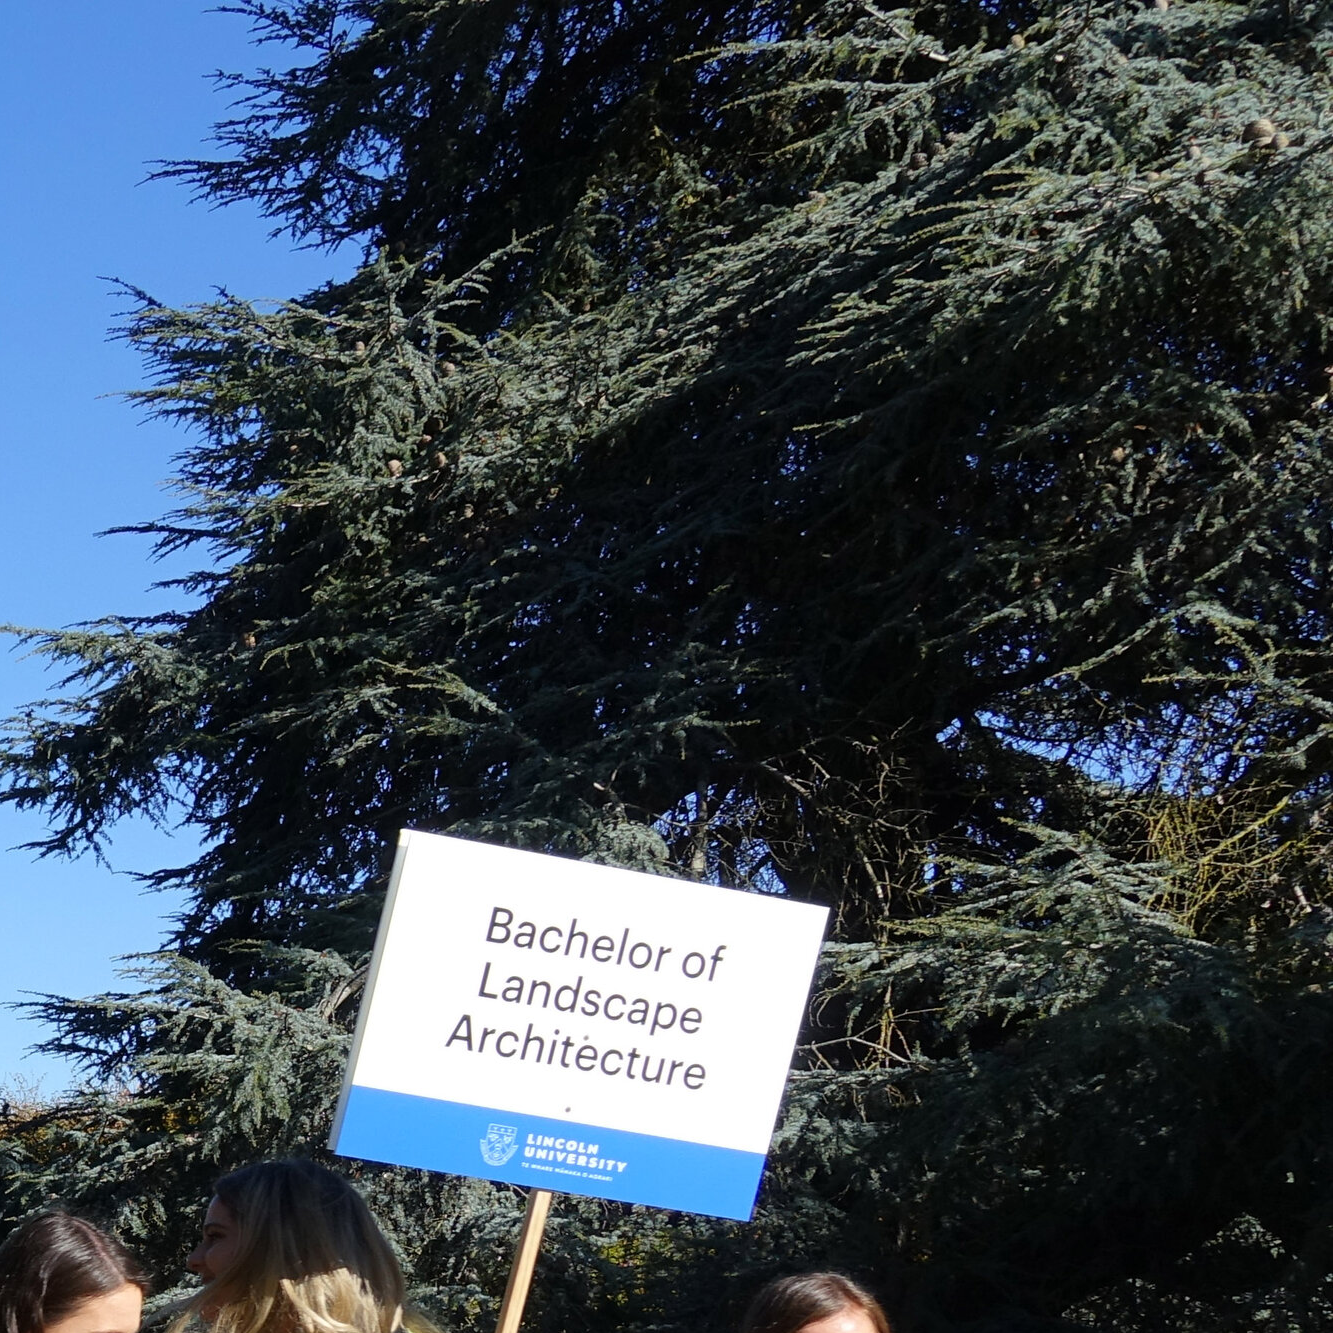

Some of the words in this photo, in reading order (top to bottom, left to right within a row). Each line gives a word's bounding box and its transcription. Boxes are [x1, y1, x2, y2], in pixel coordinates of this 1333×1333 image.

[485, 906, 672, 973] Bachelor
[682, 944, 727, 982] of
[477, 962, 703, 1036] Landscape
[445, 1014, 707, 1090] Architecture
[524, 1146, 628, 1173] UNIVERSITY
[526, 1133, 599, 1155] LINCOLN
